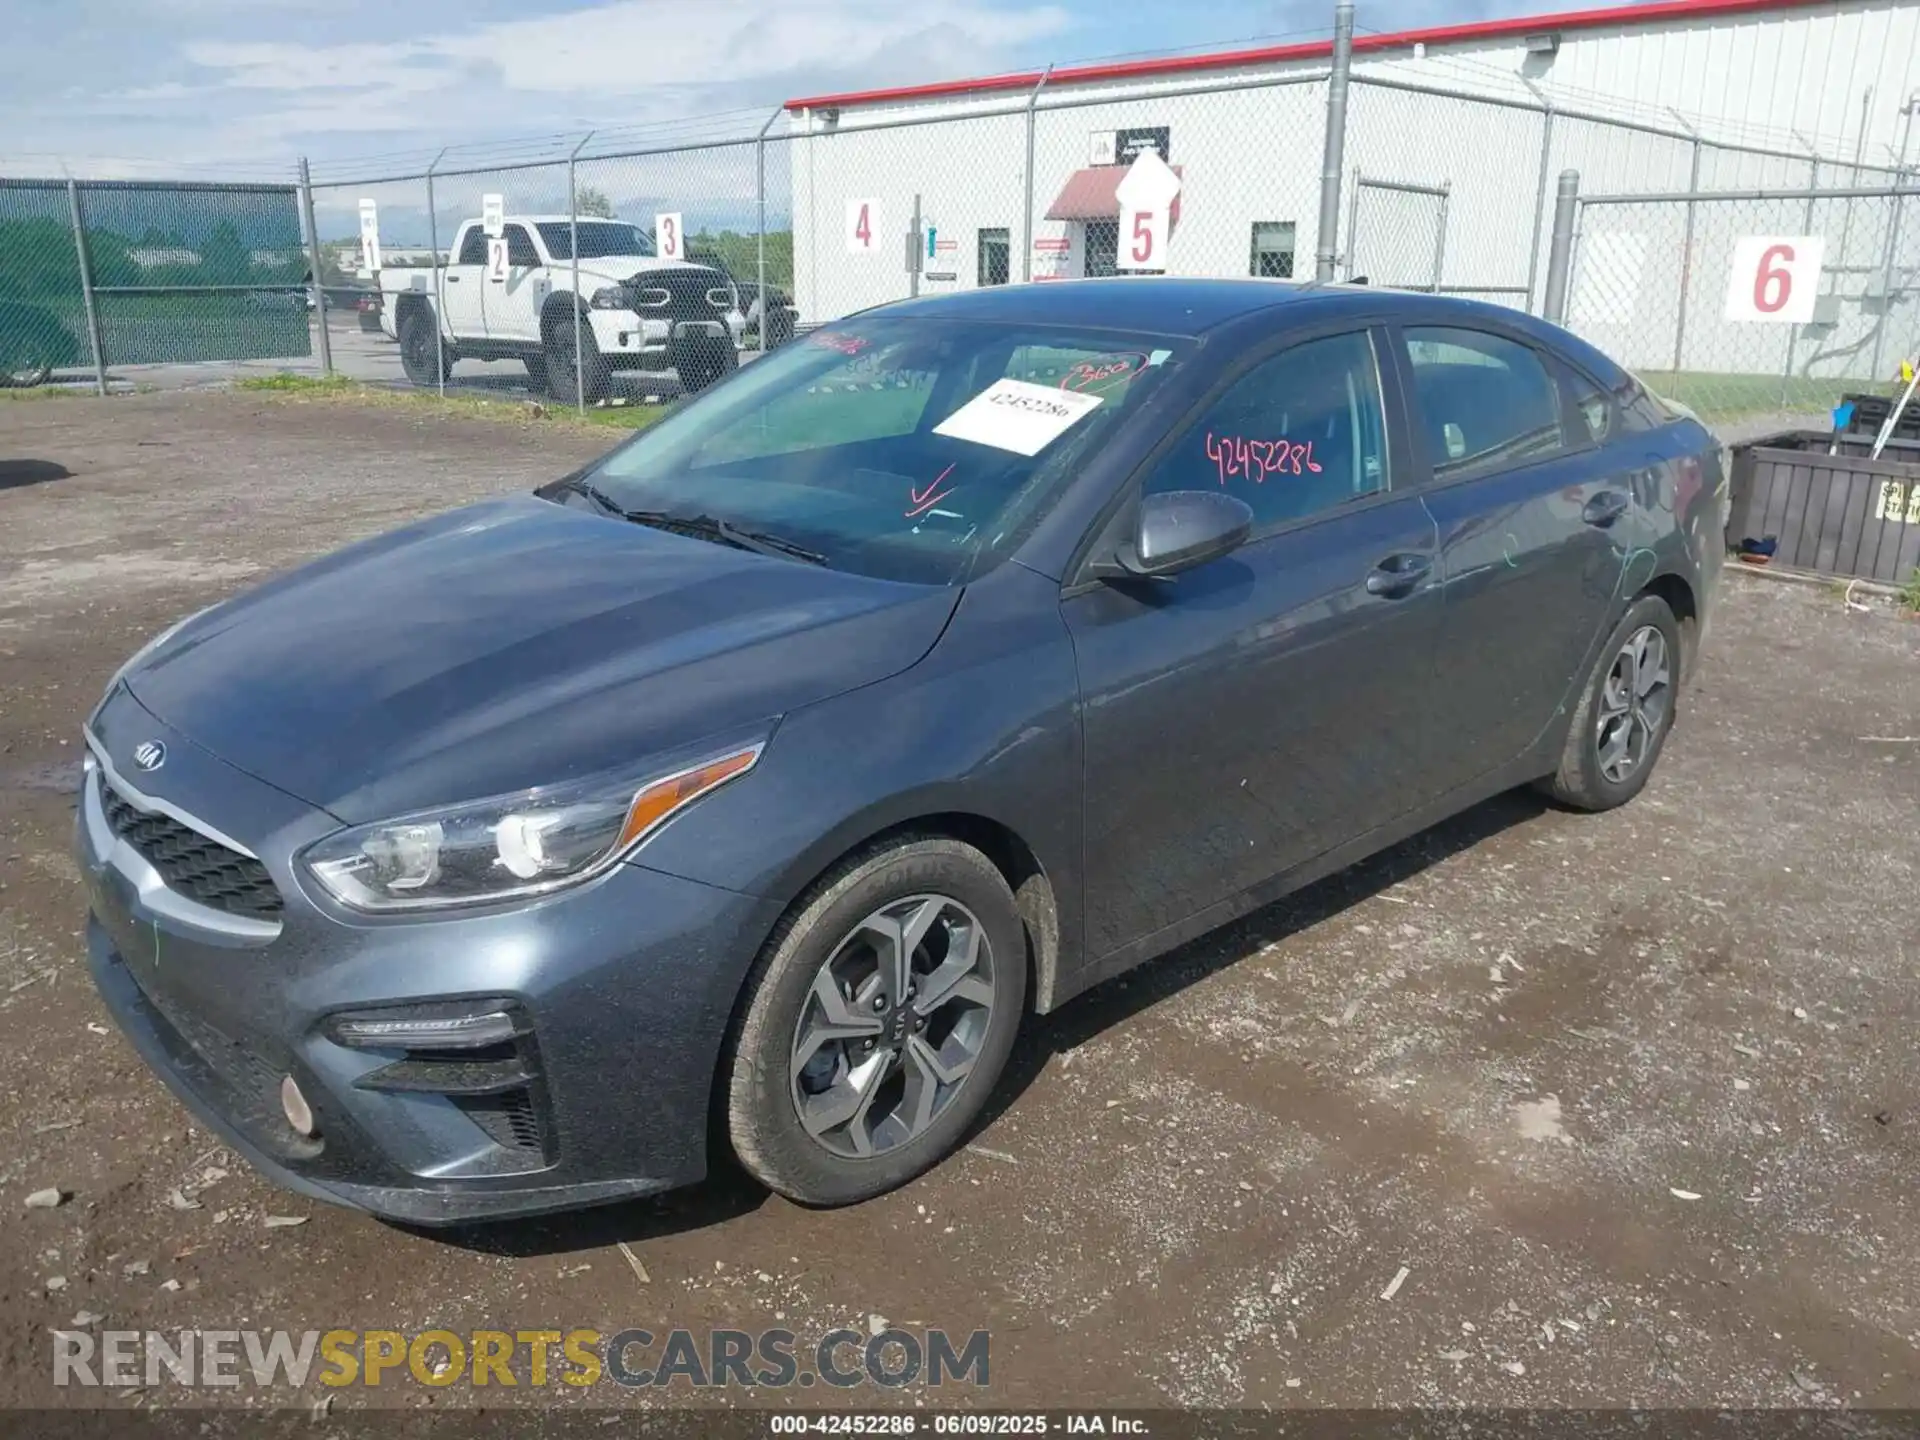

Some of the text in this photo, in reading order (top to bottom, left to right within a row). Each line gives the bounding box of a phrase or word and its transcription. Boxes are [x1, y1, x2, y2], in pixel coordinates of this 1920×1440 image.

[663, 217, 676, 256] 3
[856, 203, 872, 248] 4
[1131, 211, 1153, 262] 5
[367, 239, 375, 269] 1
[493, 243, 504, 276] 2
[1753, 244, 1795, 313] 6
[989, 393, 1070, 418] 42452286
[1206, 431, 1322, 485] 42452286
[893, 1011, 906, 1040] KIA
